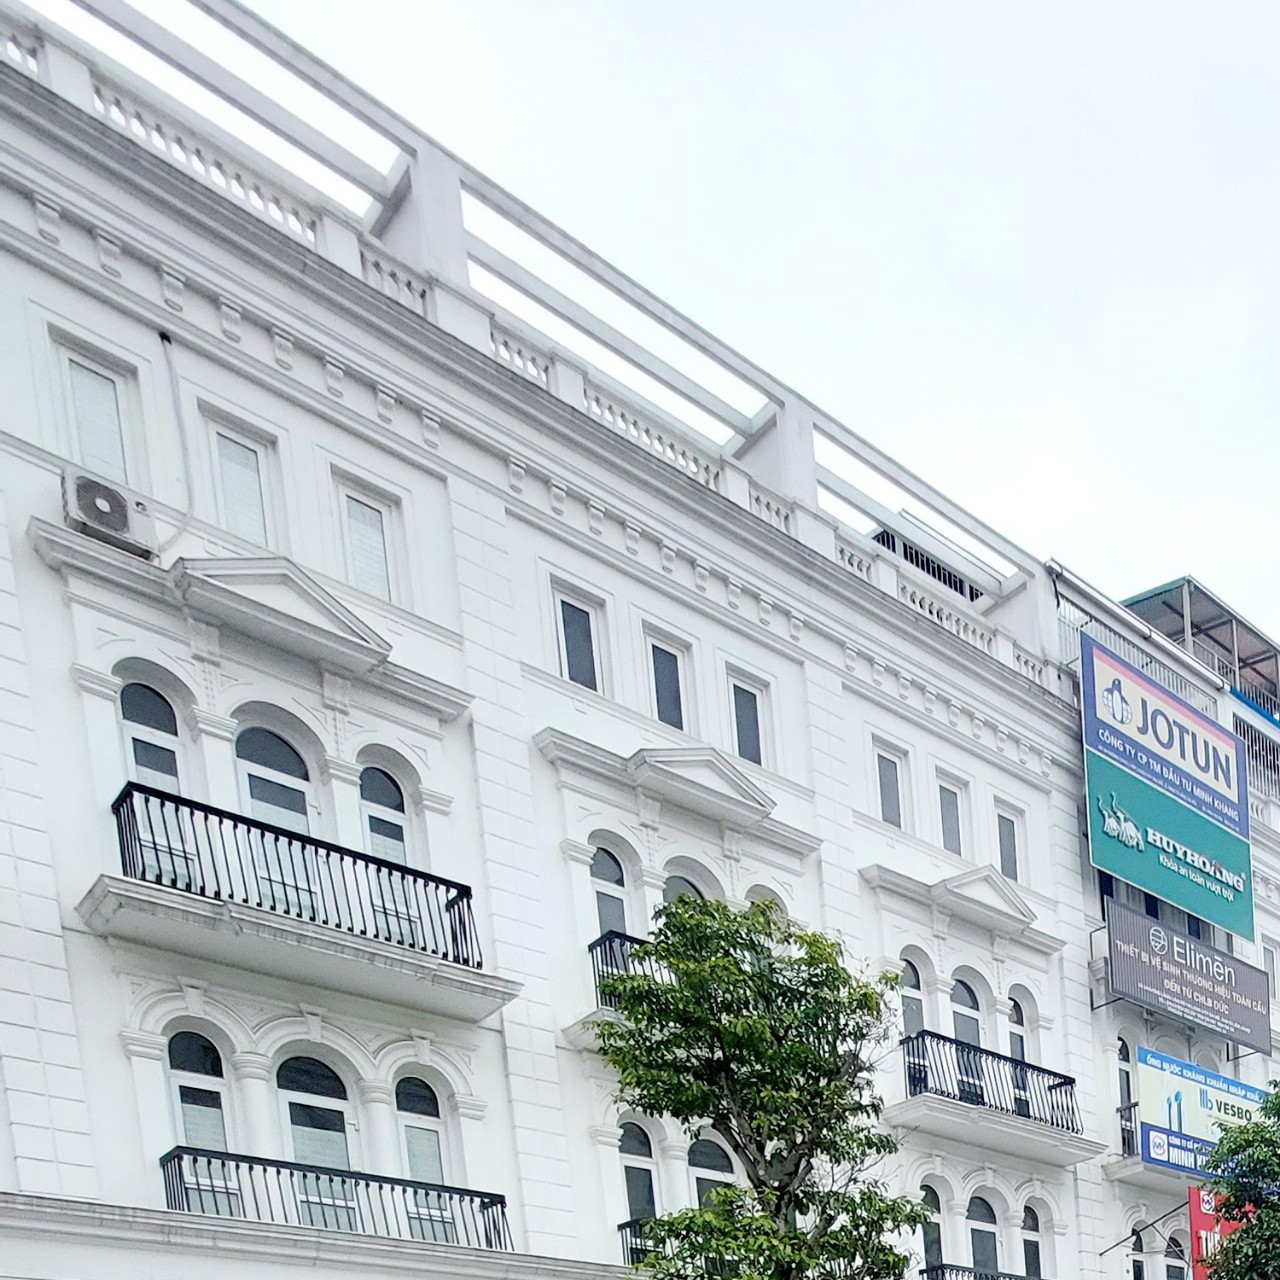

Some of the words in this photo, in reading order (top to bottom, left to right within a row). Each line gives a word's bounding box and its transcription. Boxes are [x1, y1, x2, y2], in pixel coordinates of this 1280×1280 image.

[1137, 697, 1232, 790] JOTUN
[1099, 729, 1124, 752] CÔNG
[1125, 744, 1136, 759] TY
[1138, 753, 1148, 765] CP
[1149, 758, 1161, 773] TM
[1193, 784, 1213, 805] MINH
[1214, 798, 1240, 821] KHANG
[1116, 939, 1139, 959] THIẾT
[1162, 960, 1181, 977] SINH
[1232, 990, 1251, 1009] TOÀN
[1194, 991, 1213, 1008] CHLB
[1216, 1099, 1252, 1122] VESBO
[1169, 1147, 1195, 1169] MINH
